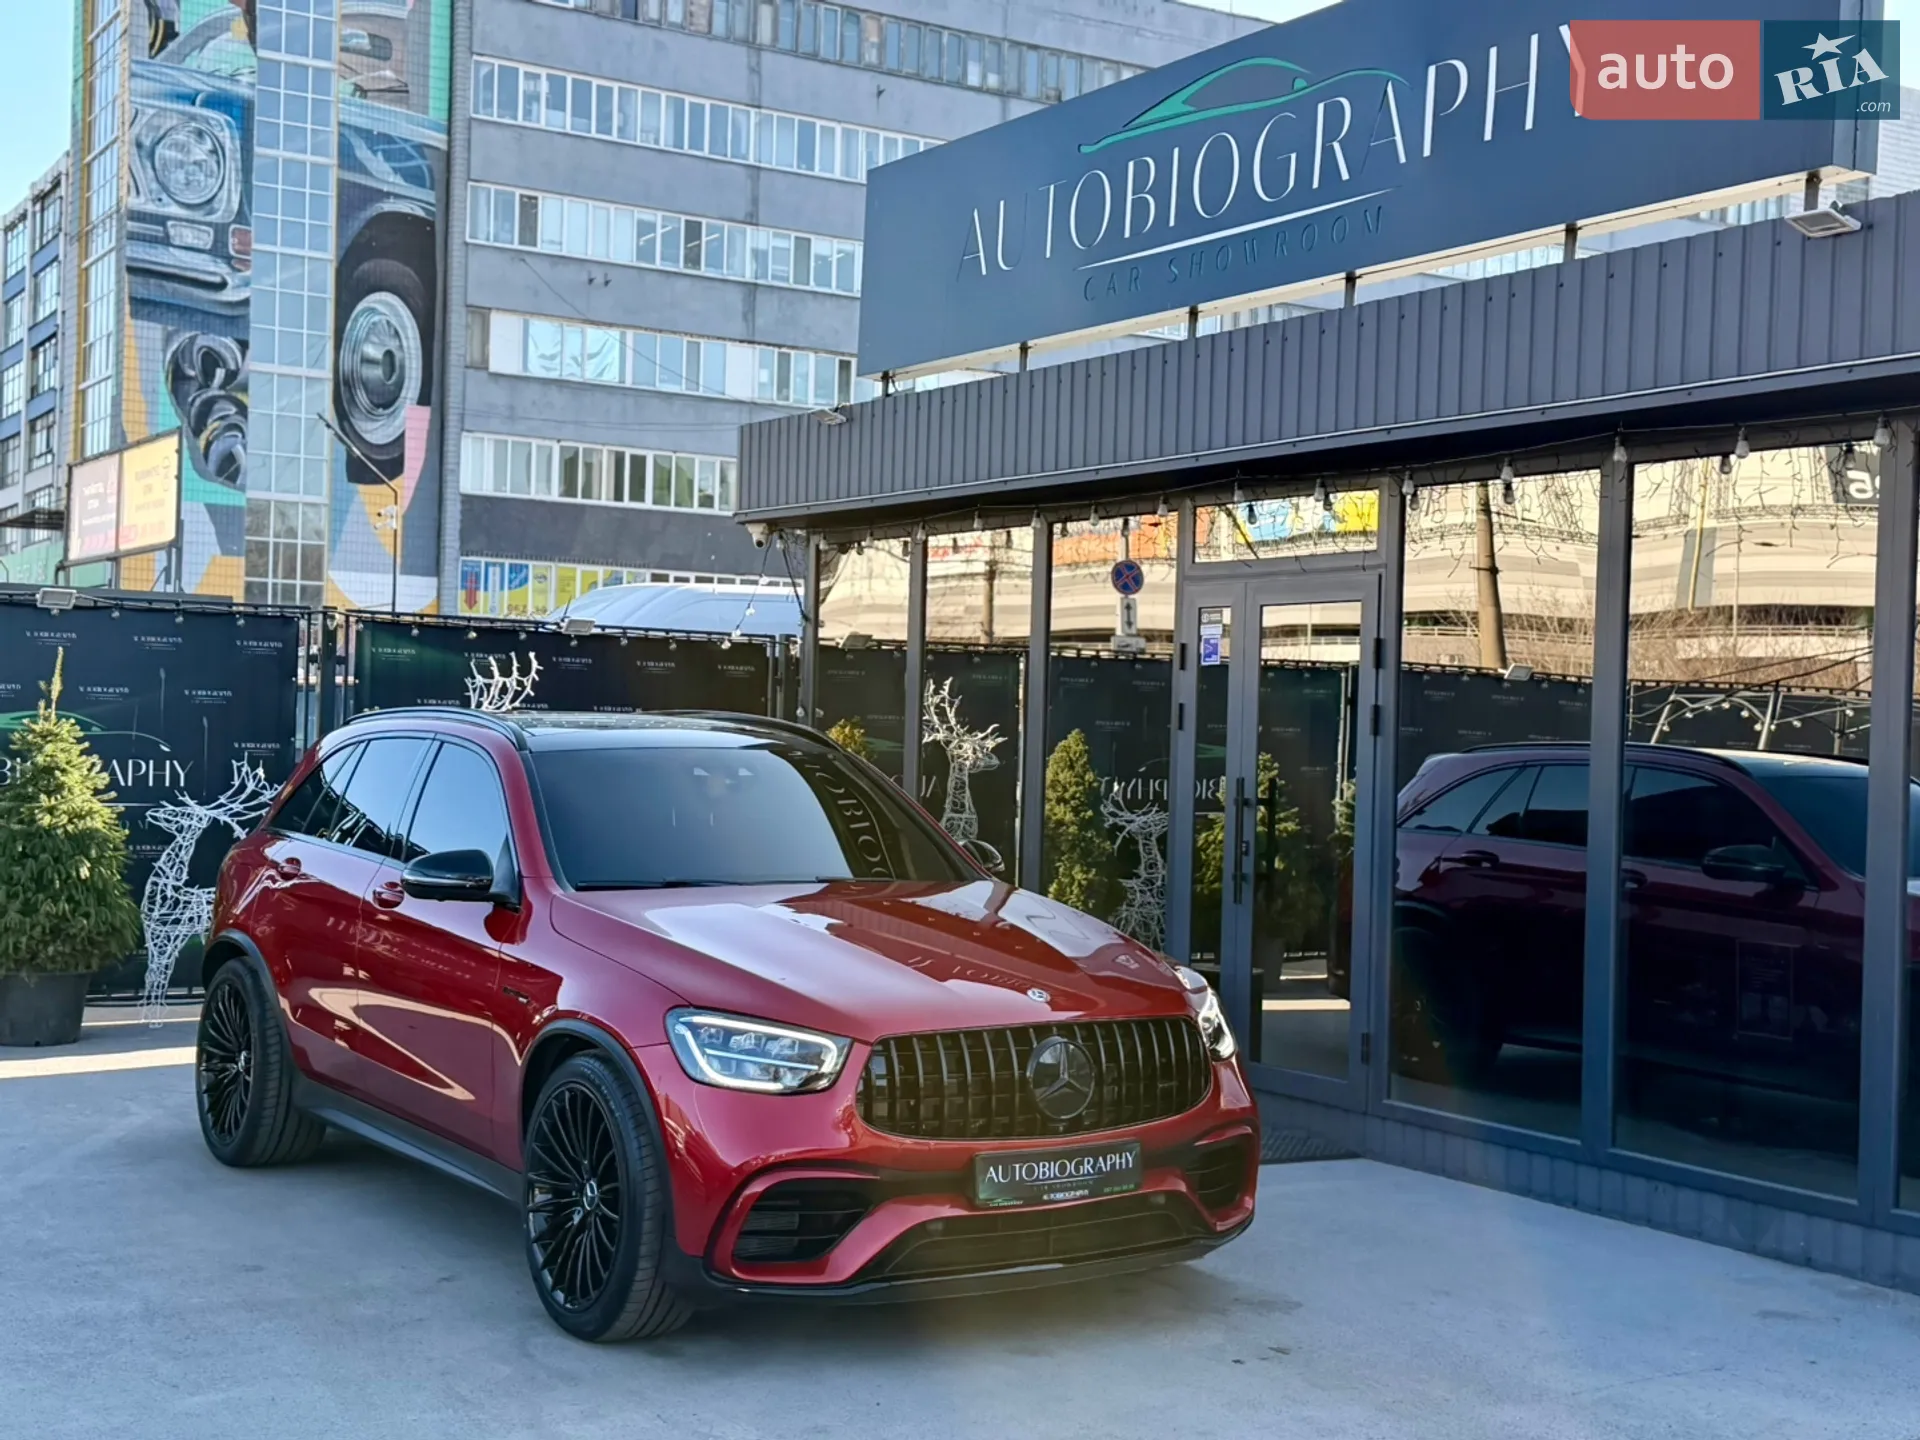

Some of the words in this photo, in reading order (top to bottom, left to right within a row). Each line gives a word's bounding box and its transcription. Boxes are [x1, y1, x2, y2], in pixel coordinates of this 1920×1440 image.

[956, 23, 1586, 283] AUTOBIOGRAPHY
[1083, 266, 1142, 302] CAR
[1167, 205, 1383, 284] SHOWROOM
[985, 1150, 1136, 1184] AUTOBIOGRAPHY
